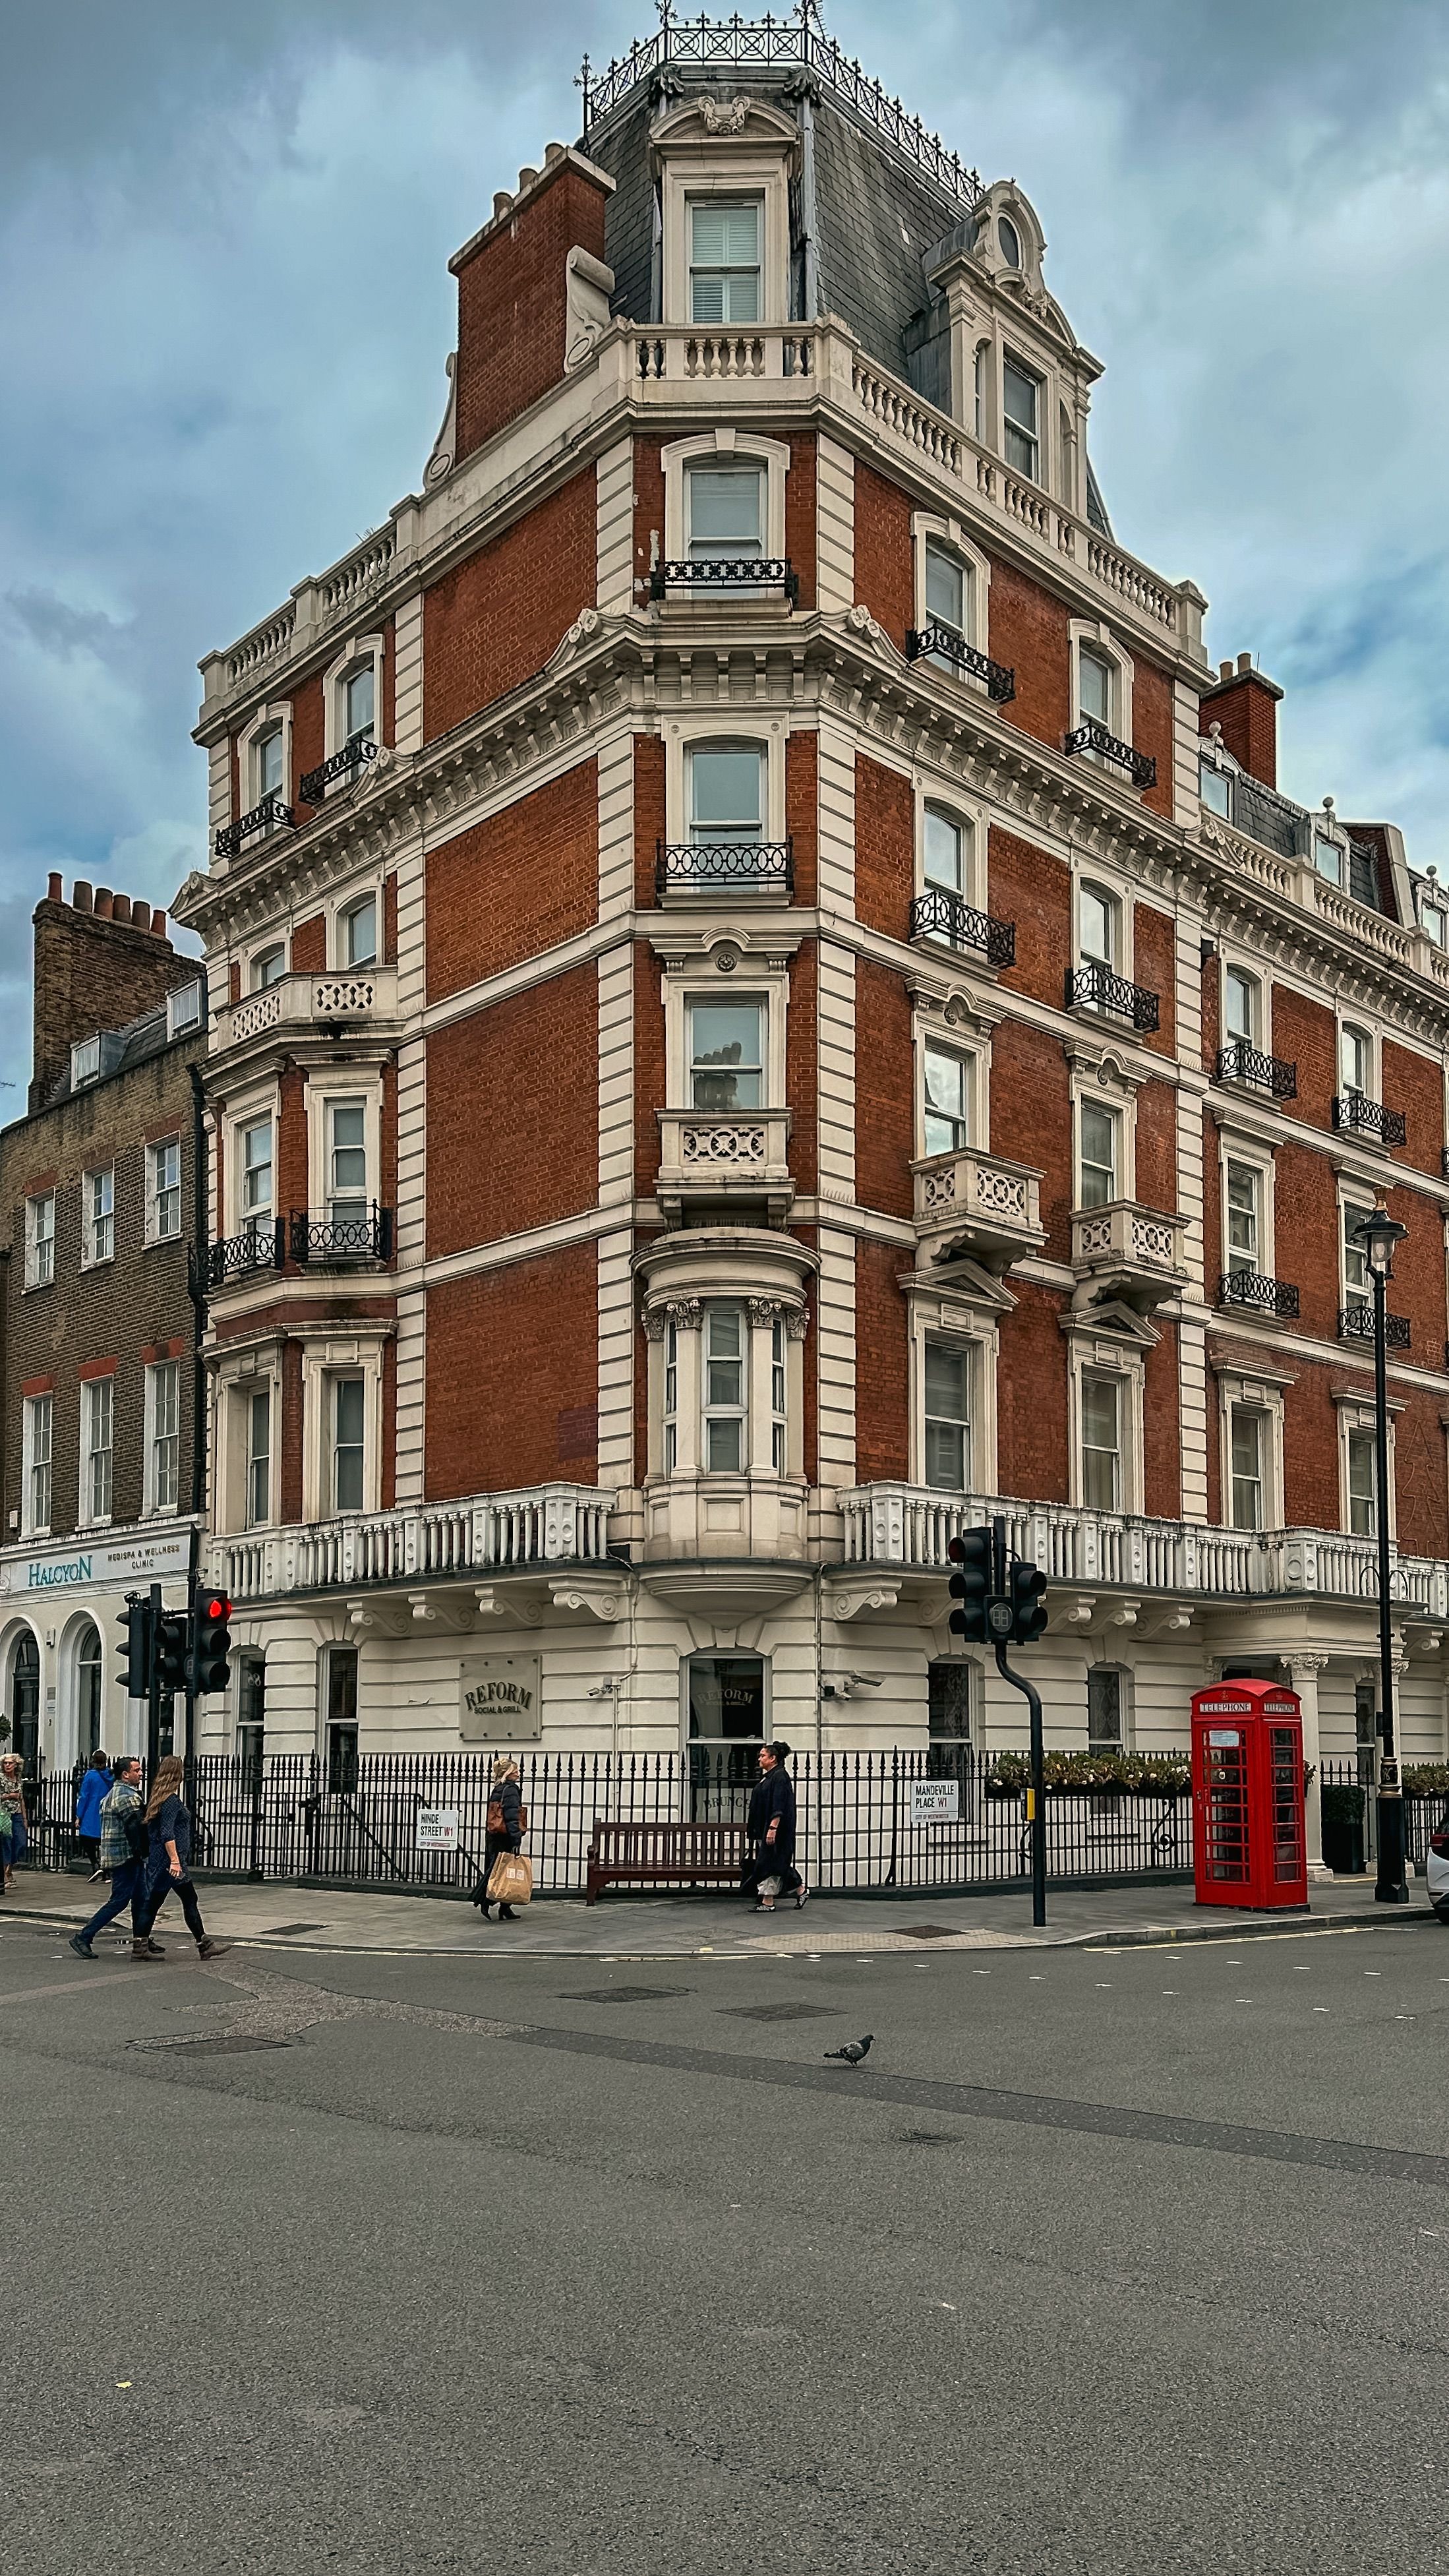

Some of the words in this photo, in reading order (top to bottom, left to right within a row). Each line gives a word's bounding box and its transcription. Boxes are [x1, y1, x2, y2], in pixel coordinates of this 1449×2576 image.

[107, 1550, 135, 1561] MEDISPA
[138, 1549, 142, 1558] &
[144, 1544, 180, 1557] WELLNESS
[131, 1559, 154, 1569] CLINIC
[464, 1681, 533, 1711] REFORM
[697, 1689, 754, 1704] REFORM
[497, 1705, 502, 1714] &
[1202, 1703, 1249, 1712] TELEPHONE
[916, 1785, 955, 1795] MANDEVILLE
[916, 1797, 935, 1808] PLACE
[937, 1797, 947, 1807] W1
[421, 1814, 439, 1824] HINDE
[421, 1826, 444, 1836] STREET
[444, 1827, 453, 1837] W1
